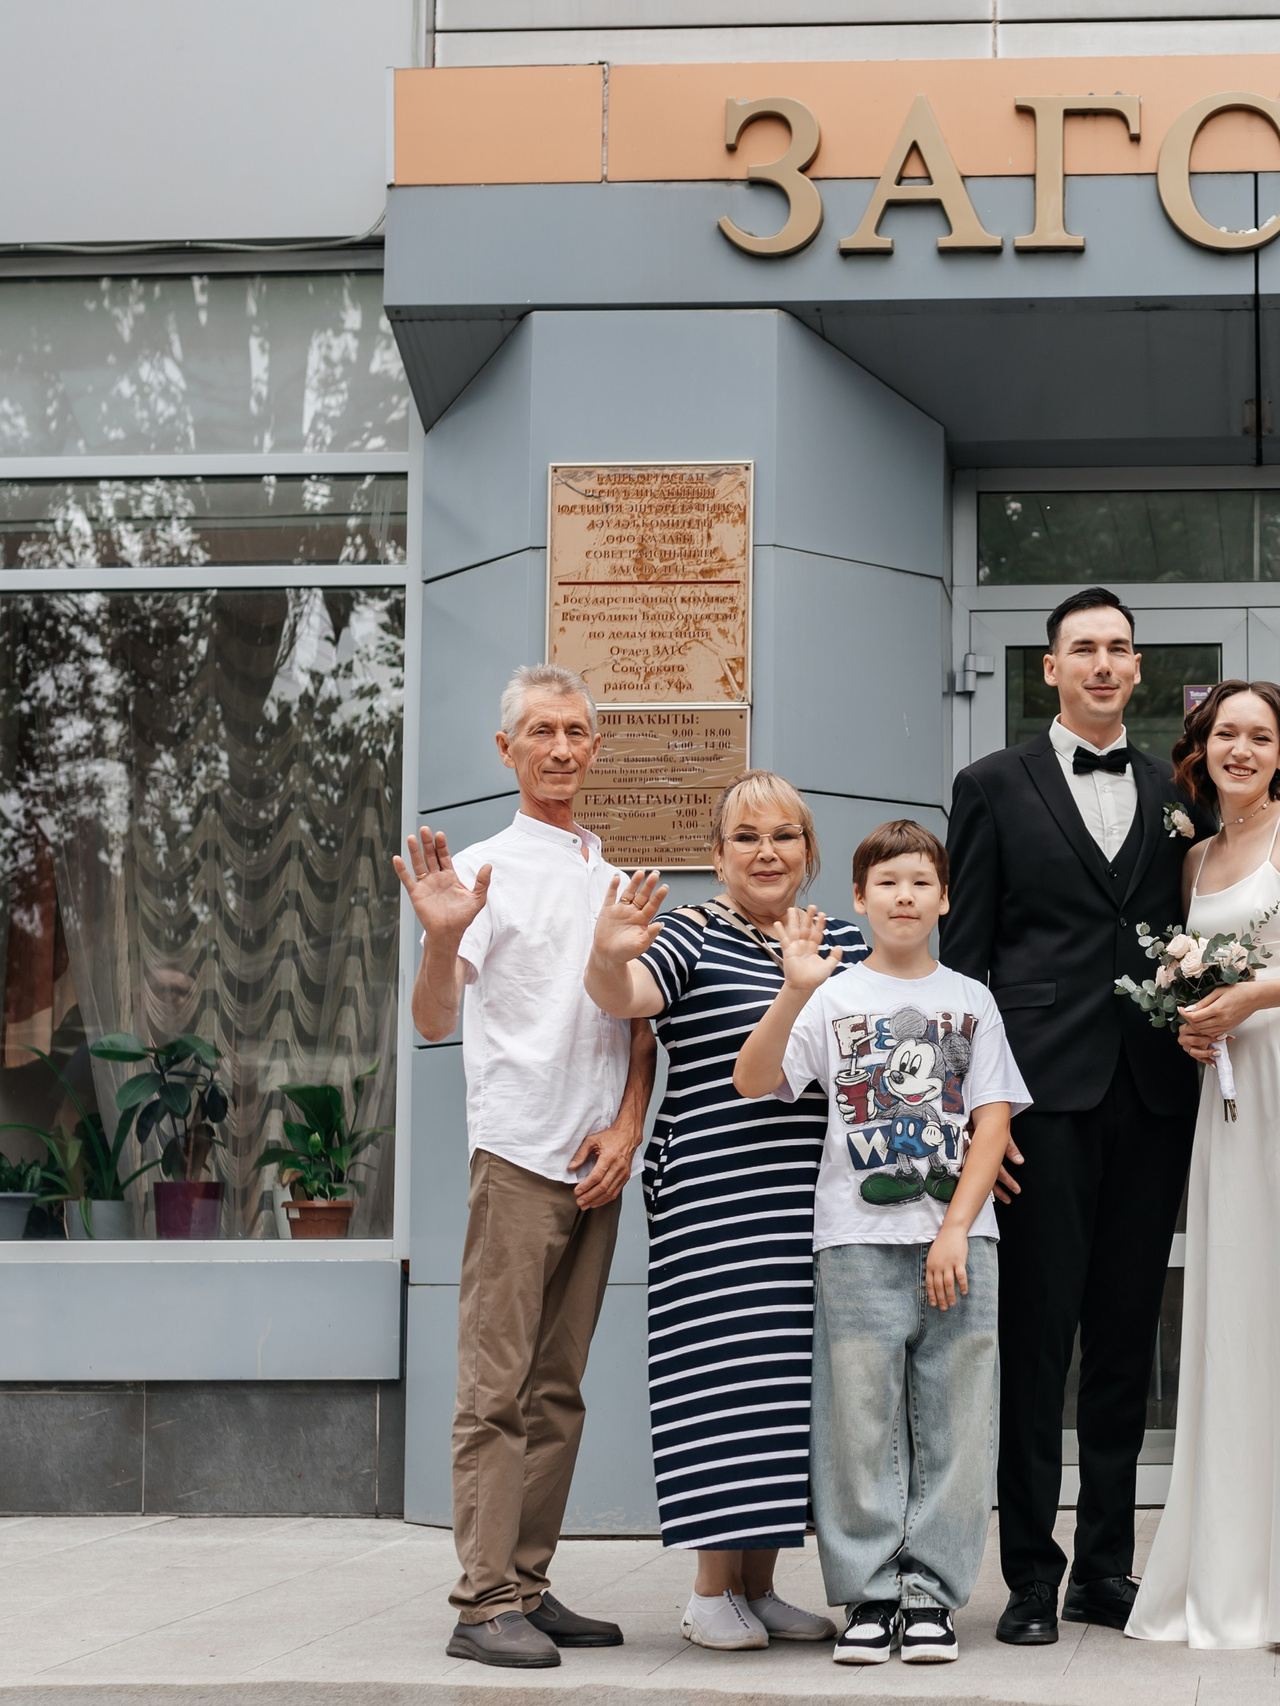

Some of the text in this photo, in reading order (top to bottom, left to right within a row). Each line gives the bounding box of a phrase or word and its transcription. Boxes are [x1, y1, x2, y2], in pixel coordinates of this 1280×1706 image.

[585, 549, 625, 559] СОВЕТ
[611, 565, 641, 575] ЗАГС
[563, 594, 735, 606] Государственный комитет
[561, 610, 738, 624] Республики Башкортостан
[588, 630, 710, 640] по делам юстиции
[610, 644, 687, 657] Отдел ЗАГС
[611, 662, 685, 673] Советского
[604, 680, 650, 694] района
[597, 714, 622, 725] ЭШ
[672, 727, 694, 738] 9.00
[704, 727, 731, 738] 18.00
[704, 740, 731, 750] 14.00
[584, 793, 712, 805] РЕЖИМ РАБОТЫ:
[618, 809, 656, 820] суббота
[675, 808, 698, 818] 9.00
[671, 820, 699, 830] 13.00
[617, 846, 650, 855] четверг
[654, 845, 691, 853] каждого
[608, 855, 663, 865] санитарный
